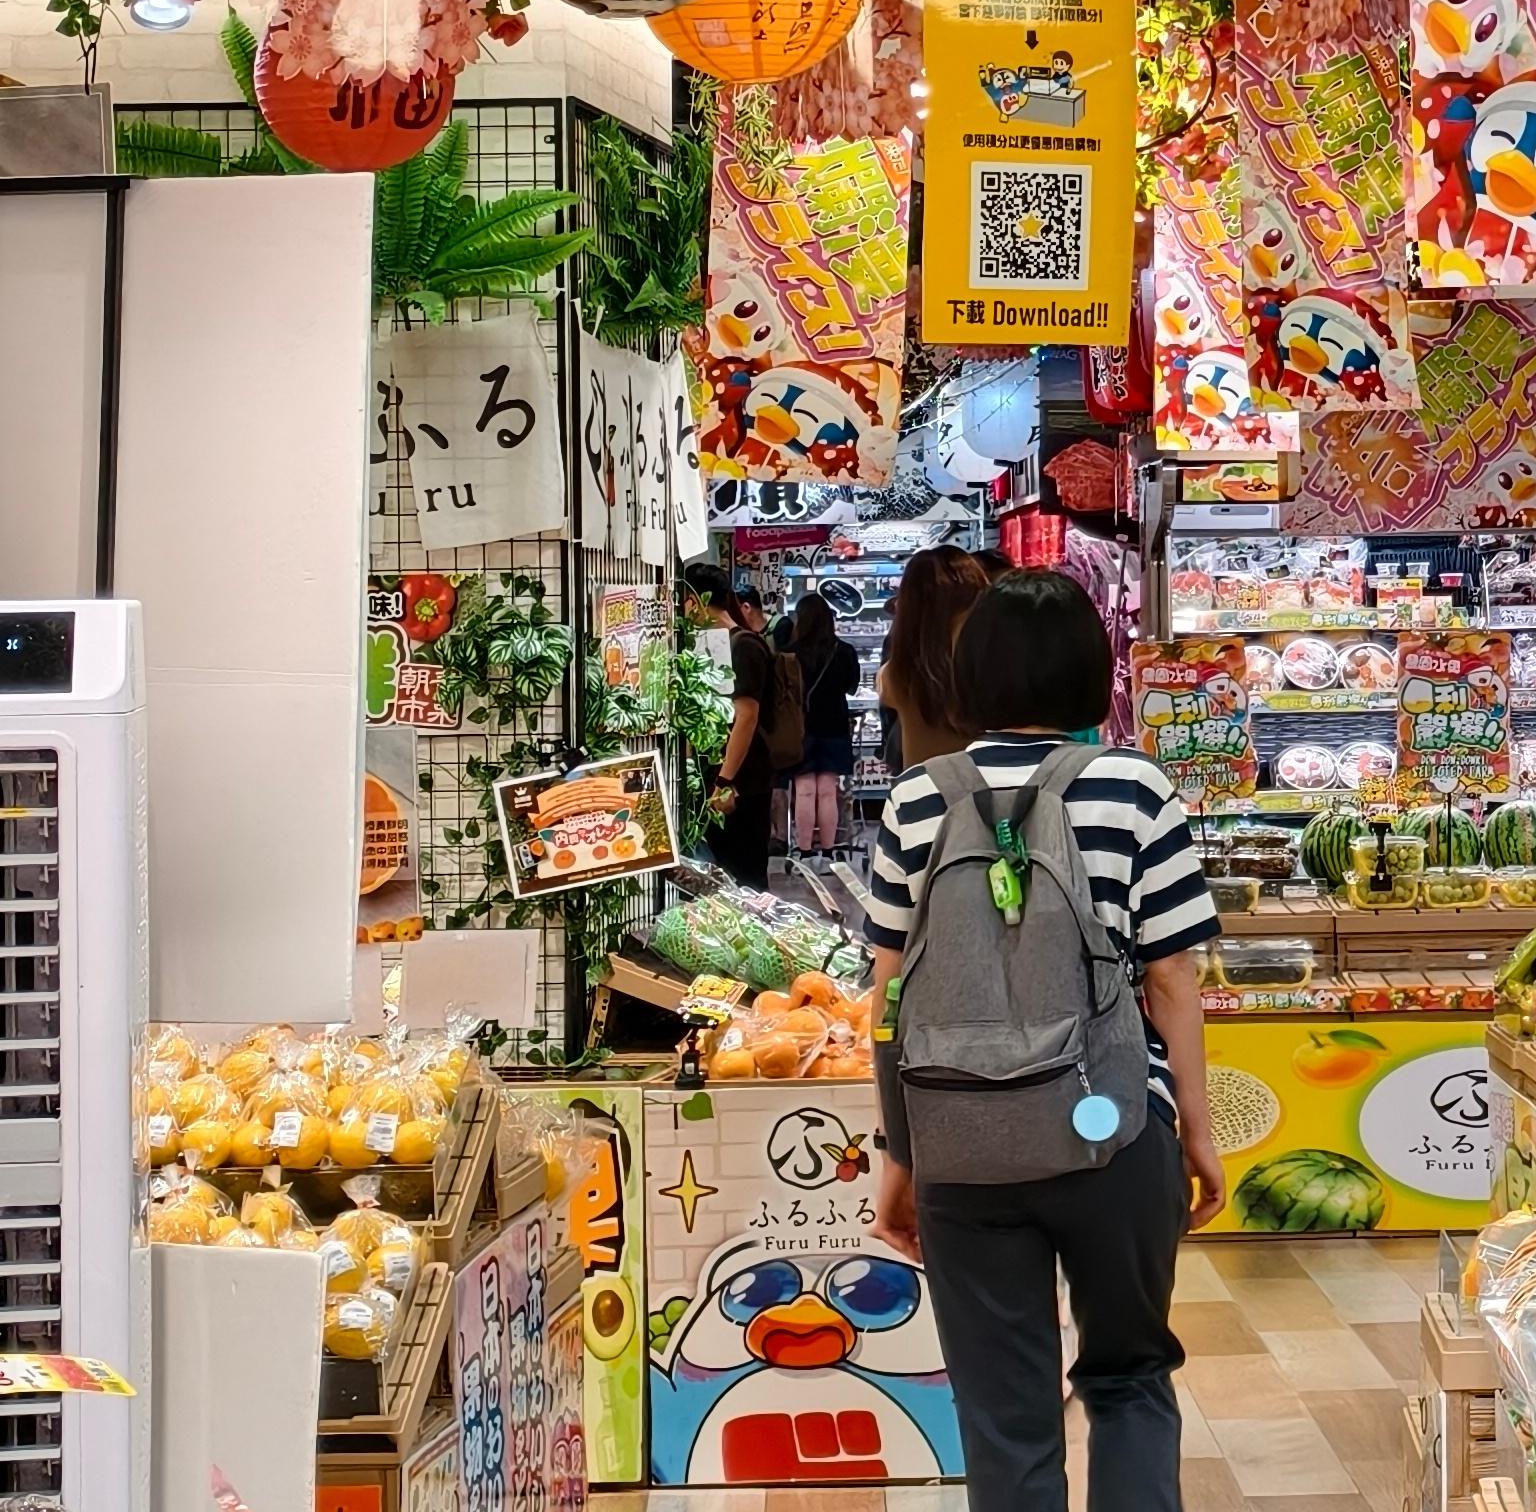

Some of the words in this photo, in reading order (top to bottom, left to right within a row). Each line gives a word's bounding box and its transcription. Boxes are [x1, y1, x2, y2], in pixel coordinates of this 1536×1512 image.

[946, 299, 986, 325] 下載
[992, 300, 1109, 328] Download!!
[1408, 1134, 1491, 1155] ふる
[1425, 1159, 1475, 1171] Furu
[749, 1196, 878, 1229] ふるふる
[763, 1235, 810, 1251] Furu
[818, 1233, 862, 1250] Furu
